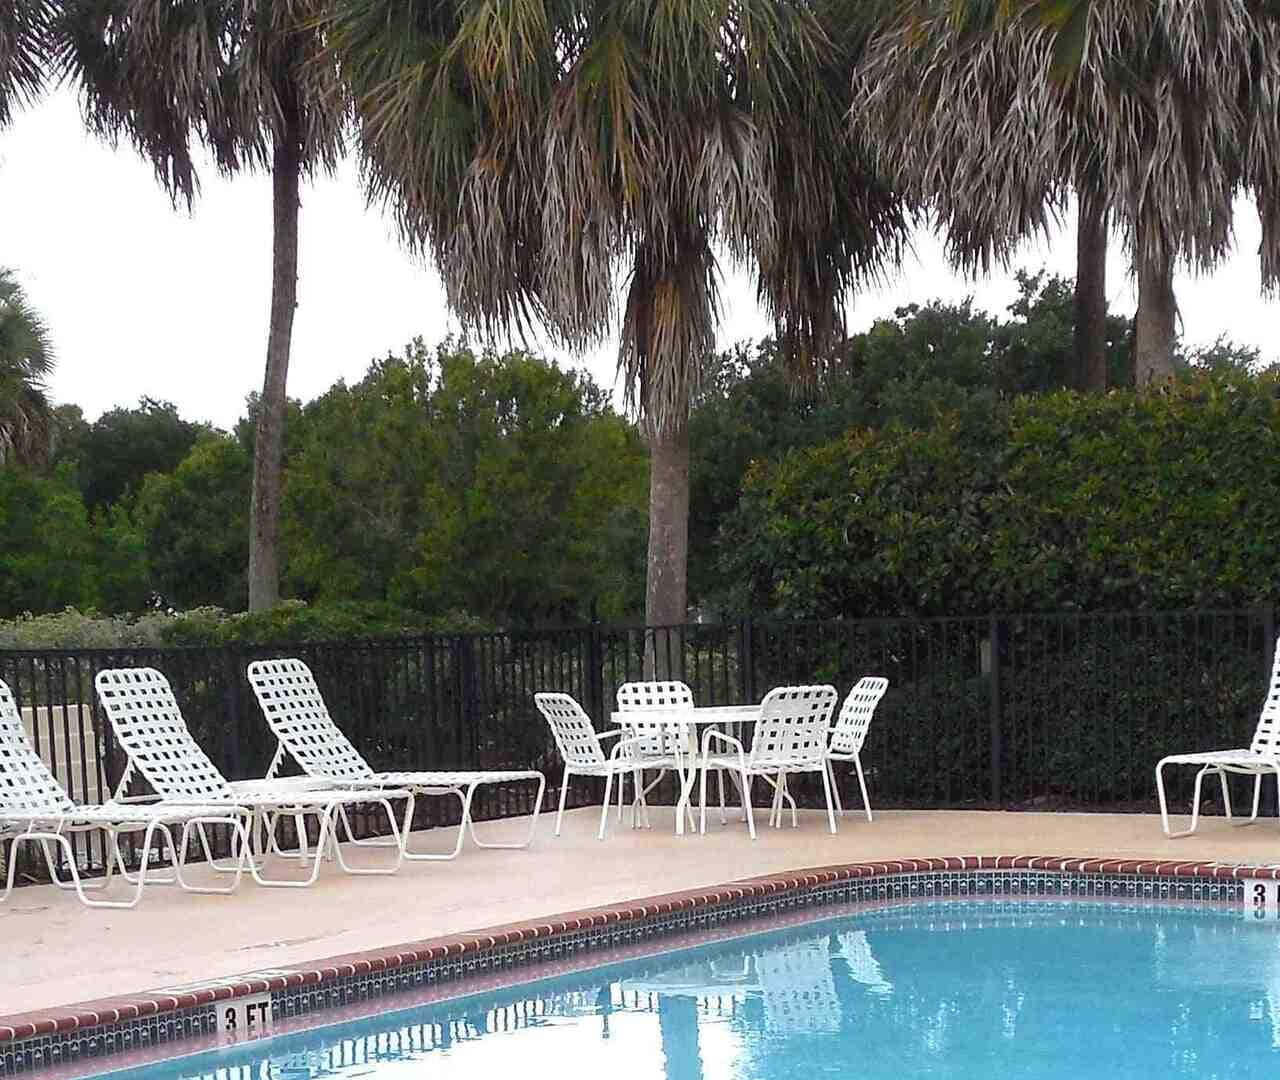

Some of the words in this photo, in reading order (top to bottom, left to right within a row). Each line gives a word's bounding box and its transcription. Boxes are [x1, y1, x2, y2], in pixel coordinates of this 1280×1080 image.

[1253, 884, 1266, 903] 3
[225, 1007, 236, 1030] 3
[246, 1001, 269, 1026] FT
